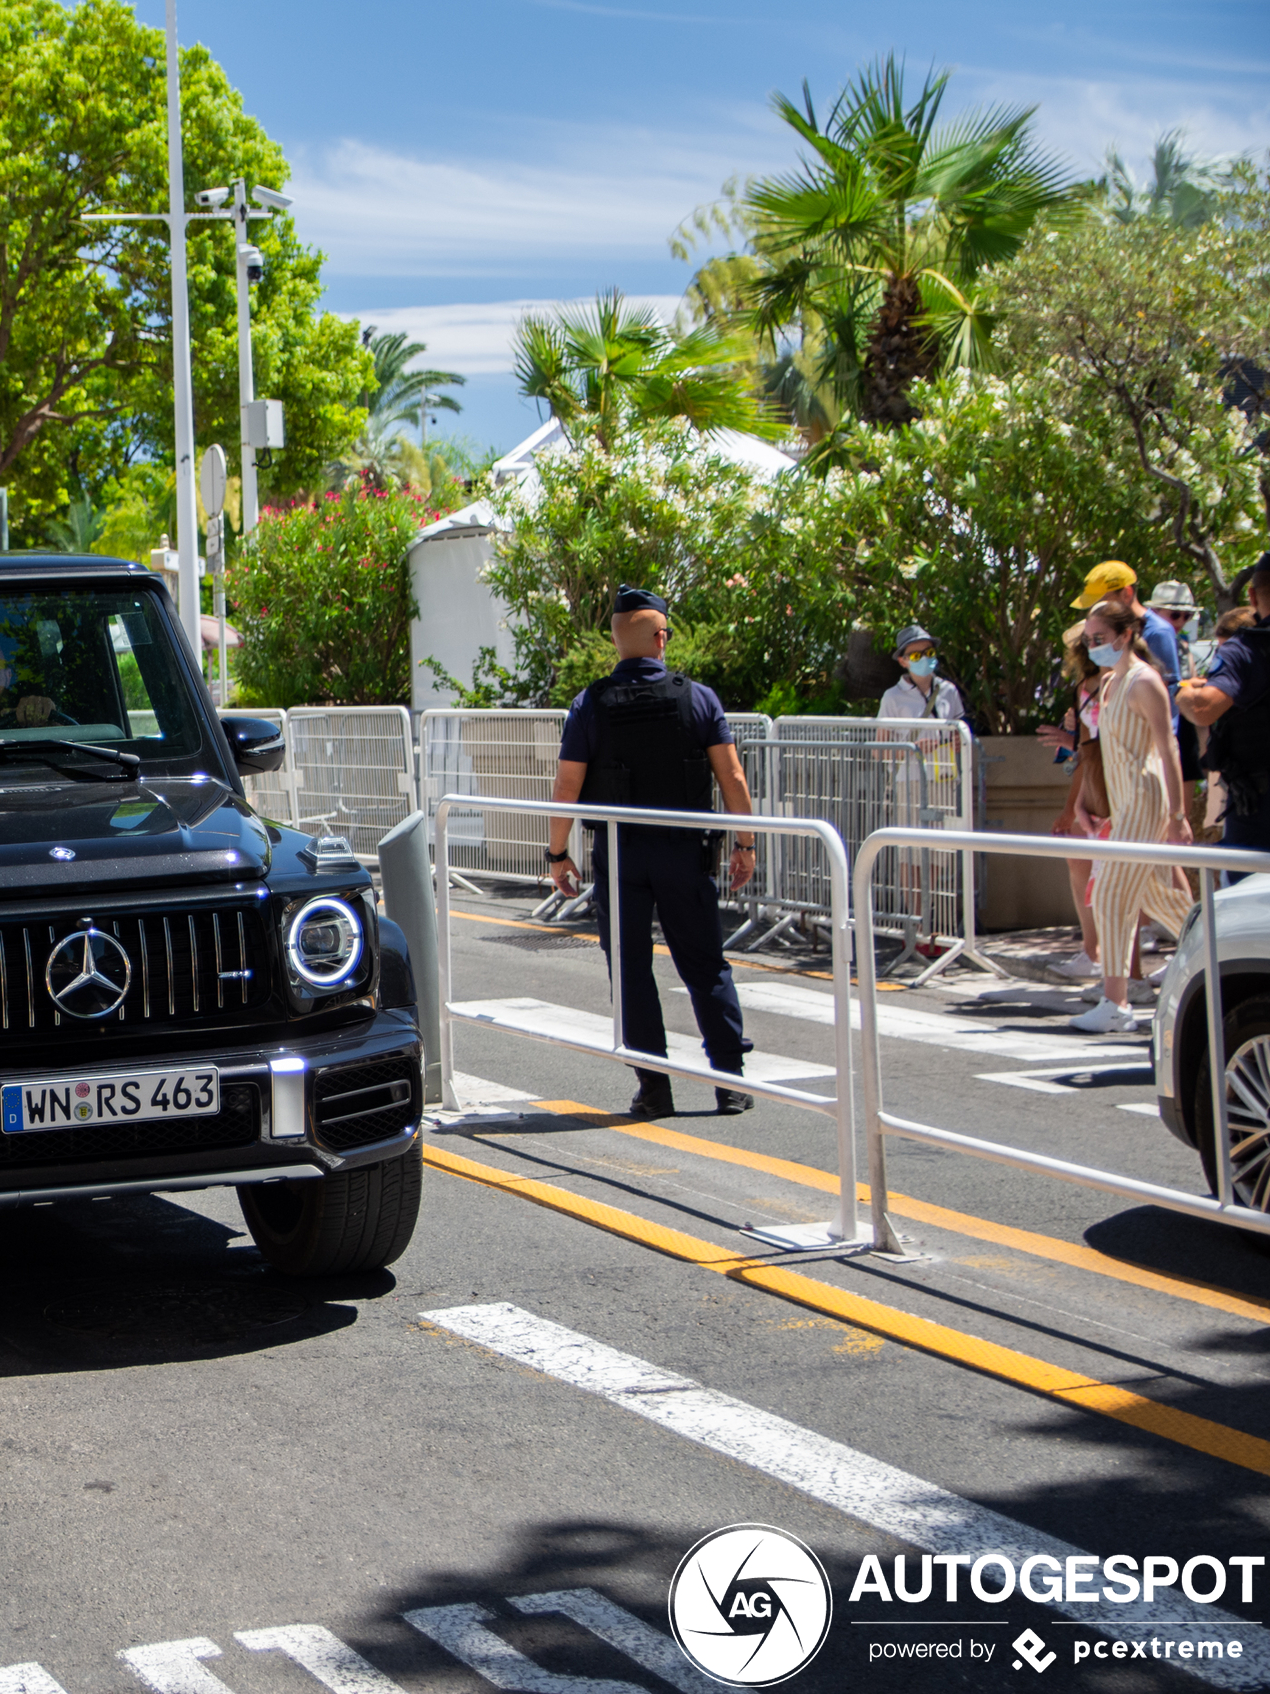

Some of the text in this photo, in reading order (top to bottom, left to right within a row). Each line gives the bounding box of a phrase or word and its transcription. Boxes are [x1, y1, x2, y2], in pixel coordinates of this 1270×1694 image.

[25, 1074, 214, 1124] WN RS 463
[9, 1113, 17, 1124] D
